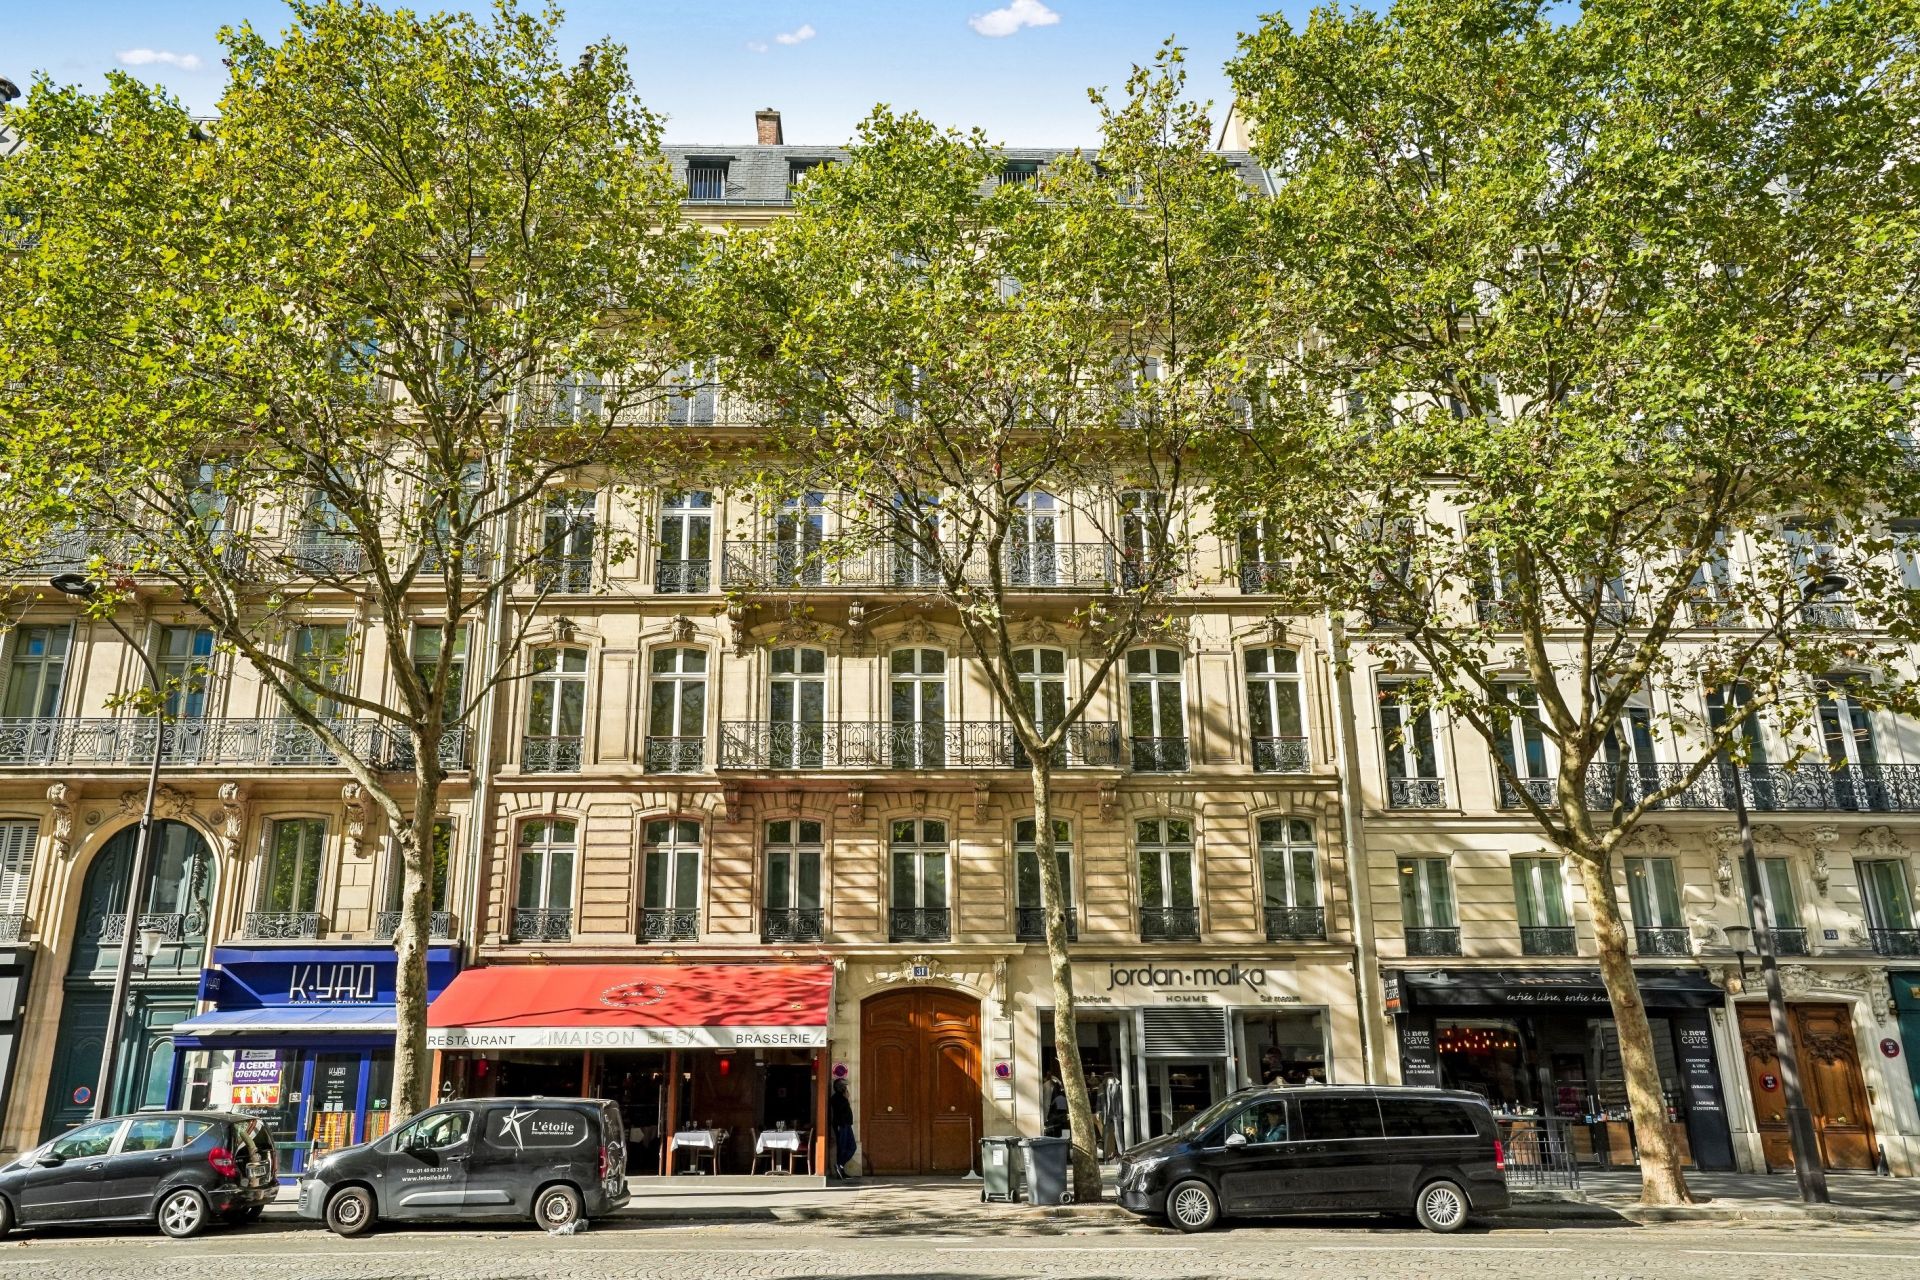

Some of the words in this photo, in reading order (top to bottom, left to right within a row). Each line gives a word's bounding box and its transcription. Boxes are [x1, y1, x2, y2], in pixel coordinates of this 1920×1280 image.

[1826, 931, 1836, 939] 33
[916, 967, 925, 976] 31
[1165, 995, 1209, 1003] HOMME
[428, 1034, 517, 1047] RESTAURANT
[735, 1033, 811, 1045] BRASSERIE
[1403, 1037, 1430, 1045] cave
[1681, 1036, 1708, 1045] cave
[238, 1062, 246, 1070] A
[531, 1121, 575, 1132] L'étoile
